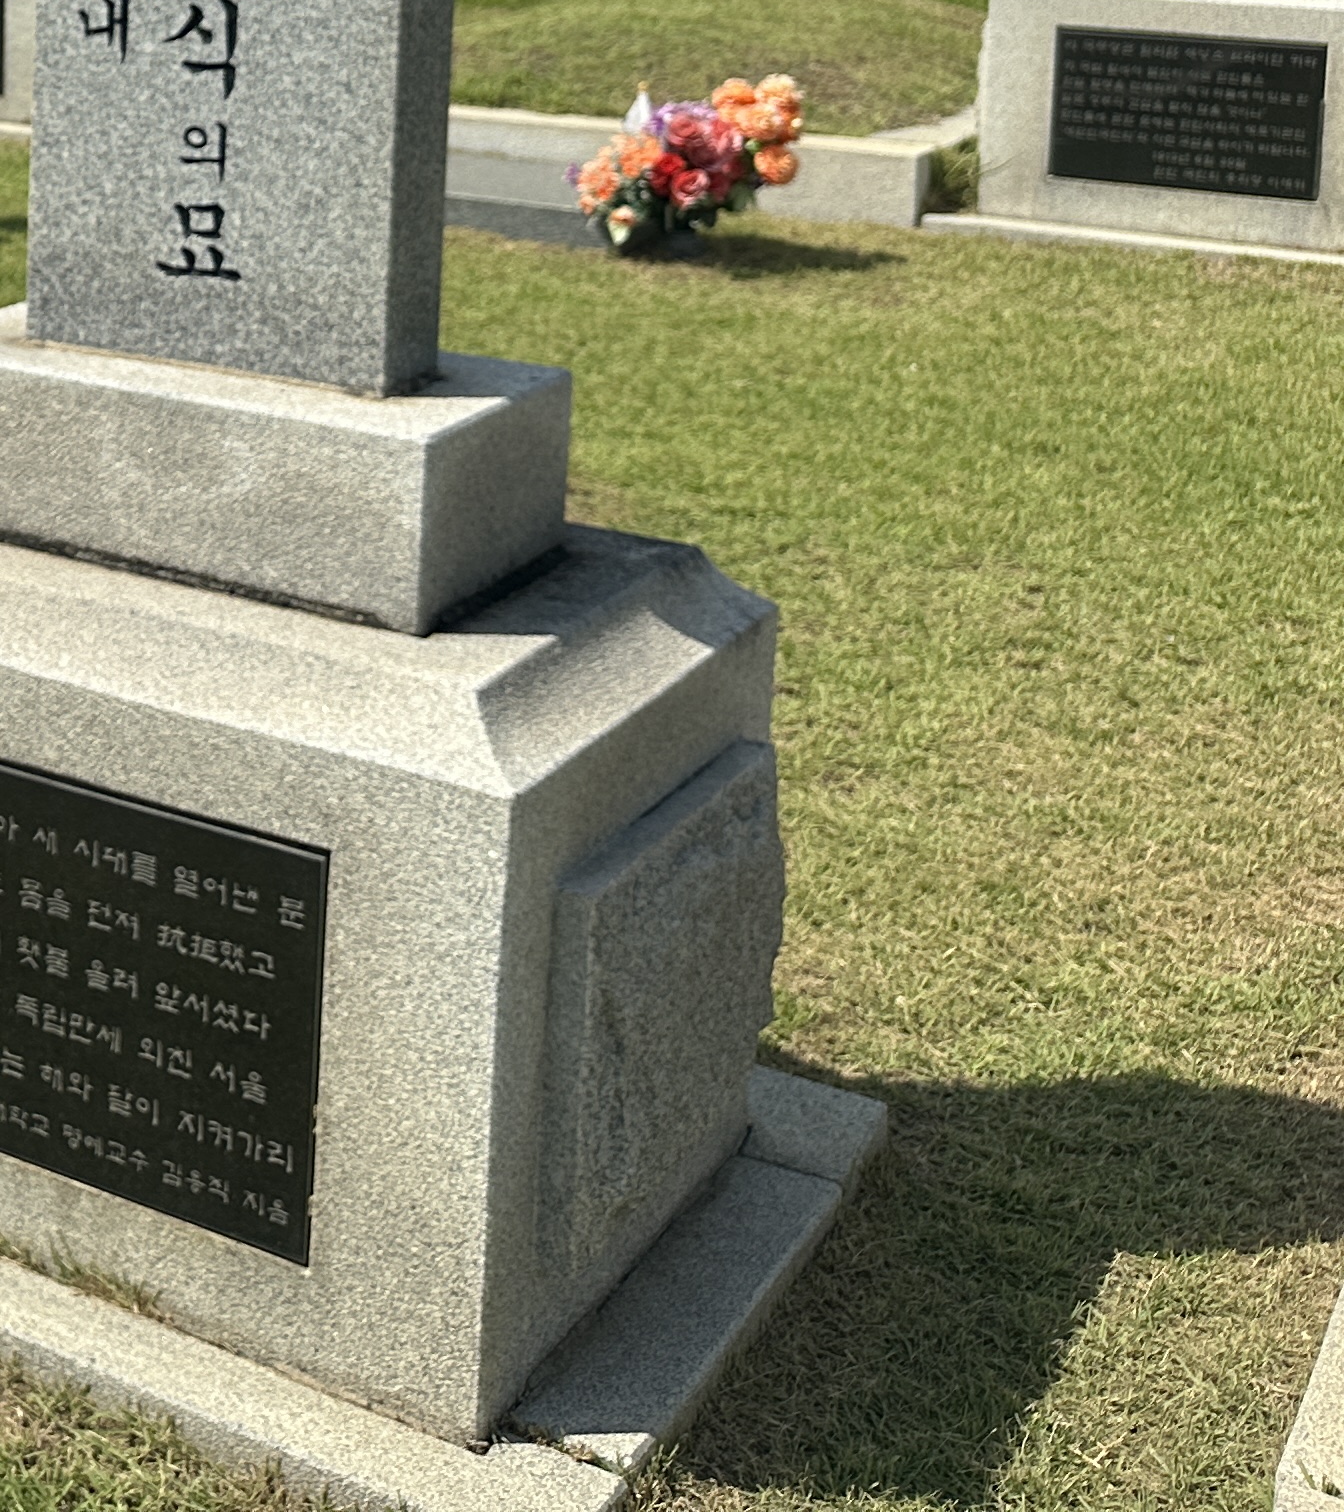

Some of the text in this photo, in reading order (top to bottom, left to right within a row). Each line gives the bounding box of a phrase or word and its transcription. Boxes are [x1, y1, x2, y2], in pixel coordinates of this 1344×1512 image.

[18, 878, 70, 919] 몸을
[87, 899, 139, 939] 던져
[32, 827, 57, 854] 새
[73, 839, 156, 886] 시대를
[173, 865, 258, 913] 열어낸
[277, 895, 305, 929] 분
[85, 959, 137, 998] 올려
[154, 981, 270, 1039] 앞서셨다
[15, 993, 121, 1053] 독립만세
[137, 1037, 192, 1079] 외친
[209, 1062, 266, 1104] 서울
[39, 1064, 93, 1101] 해와
[108, 1083, 158, 1125] 달이
[177, 1110, 292, 1173] 지켜가리
[242, 1190, 289, 1225] 지음
